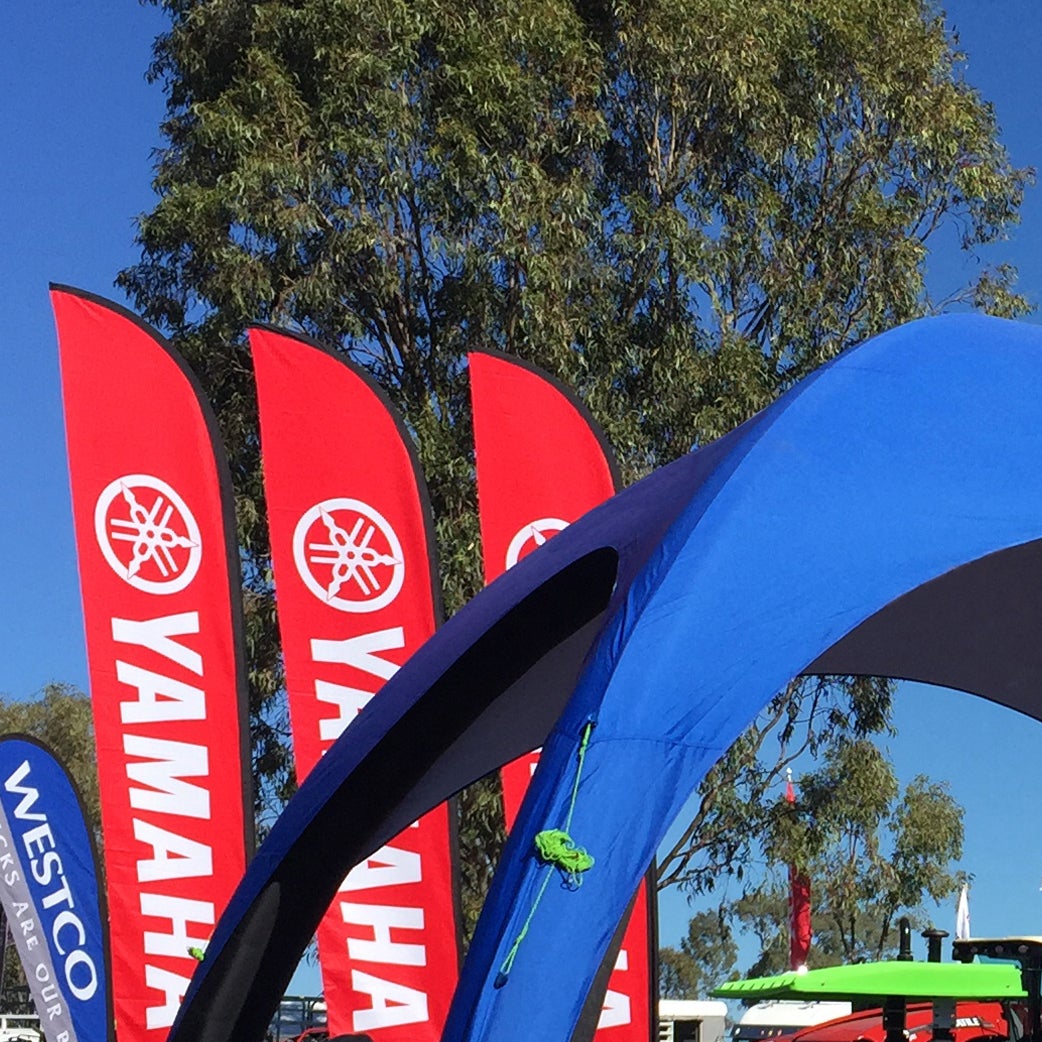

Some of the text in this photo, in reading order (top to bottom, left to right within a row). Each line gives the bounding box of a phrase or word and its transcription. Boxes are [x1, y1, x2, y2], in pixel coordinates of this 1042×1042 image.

[4, 759, 98, 1001] WESTCO
[12, 901, 39, 951] ARE
[35, 962, 62, 1021] OUR
